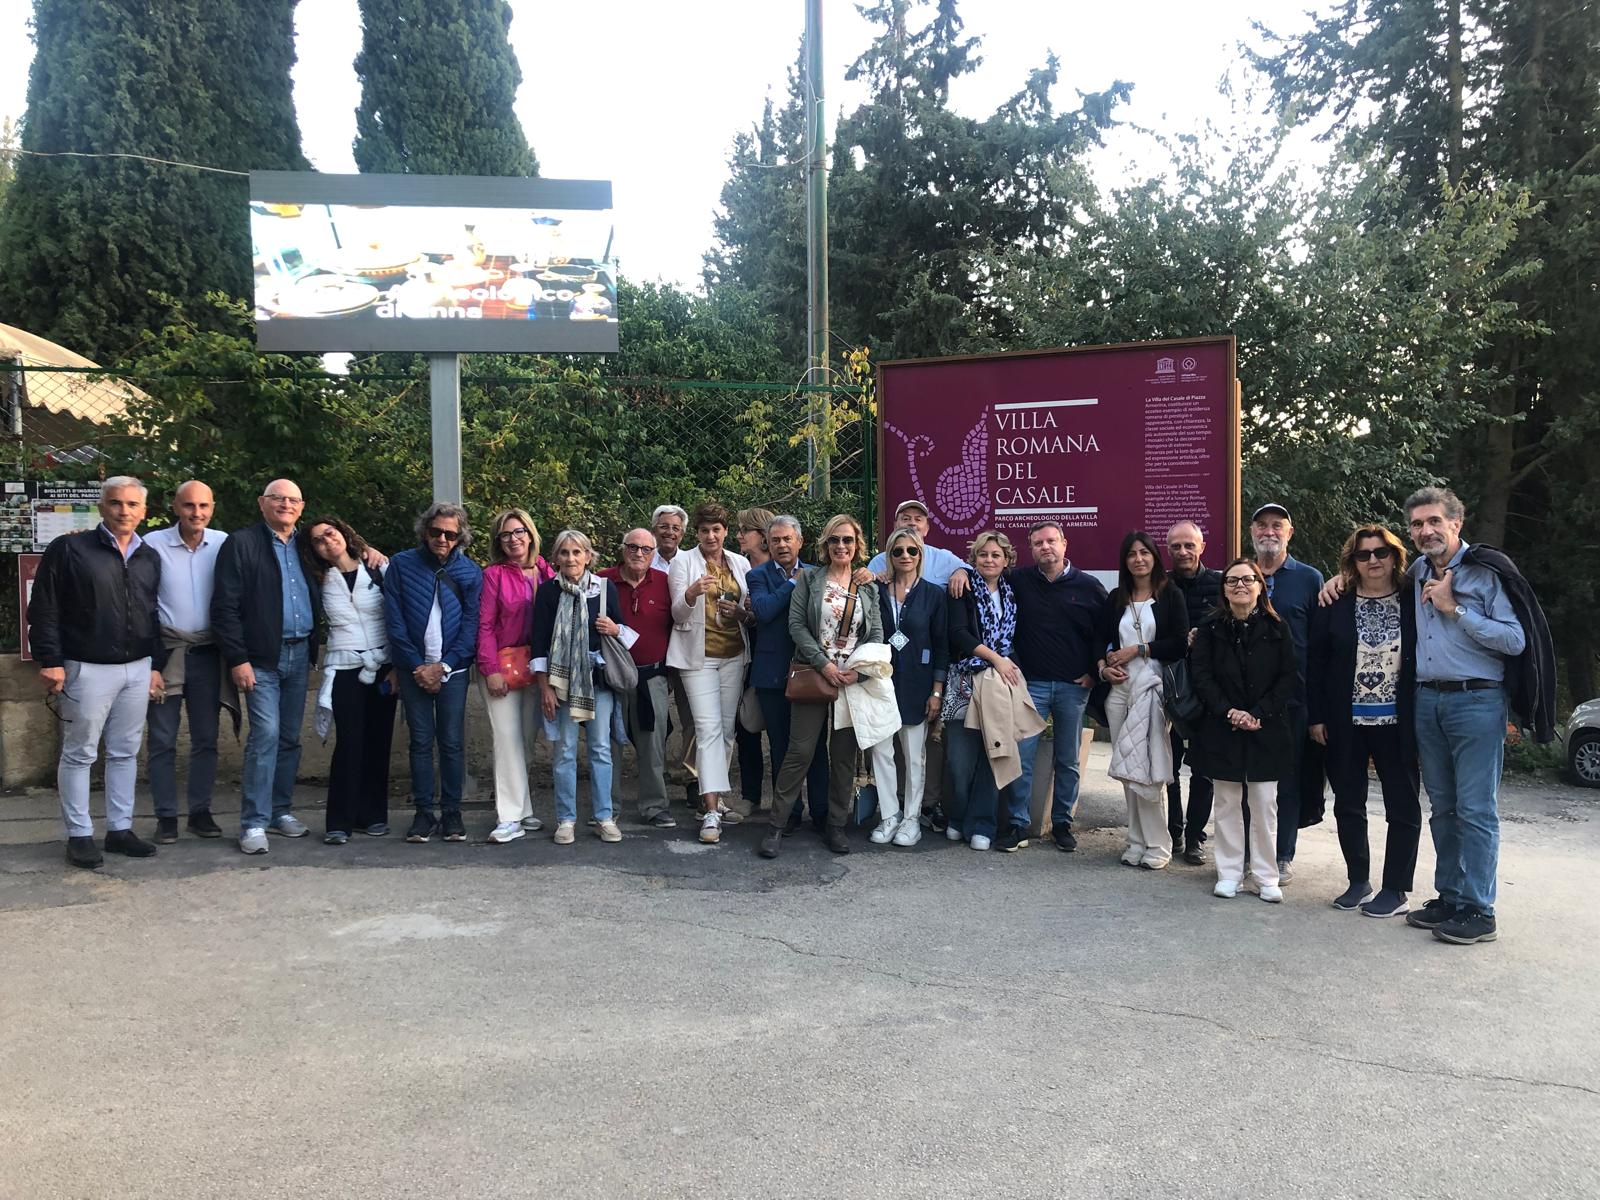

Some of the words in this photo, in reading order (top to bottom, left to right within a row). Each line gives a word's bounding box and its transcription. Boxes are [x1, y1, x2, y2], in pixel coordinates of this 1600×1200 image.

[995, 411, 1058, 430] VILLA
[996, 434, 1100, 456] ROMANA
[996, 462, 1038, 480] DEL
[995, 486, 1076, 504] CASALE
